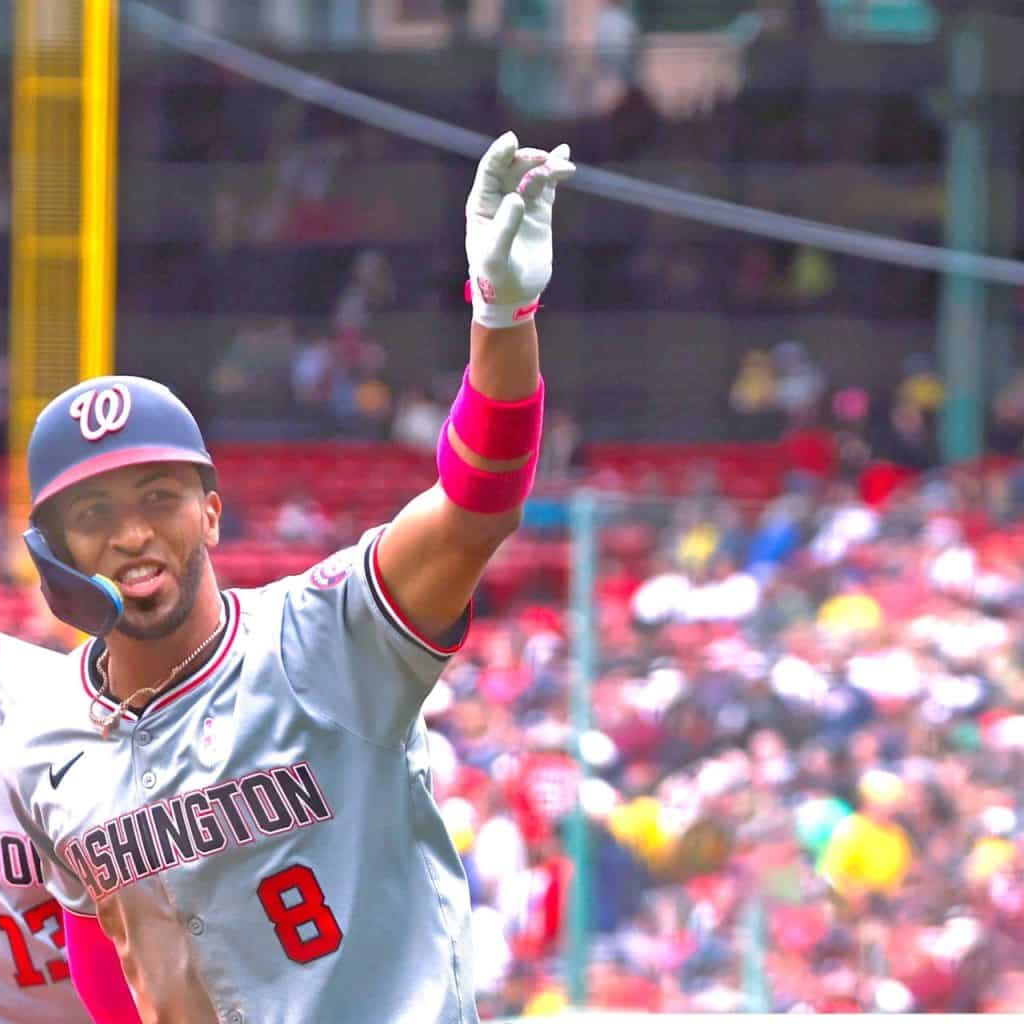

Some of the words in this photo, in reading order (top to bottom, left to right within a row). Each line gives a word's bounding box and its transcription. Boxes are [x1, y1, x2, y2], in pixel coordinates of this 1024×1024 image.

[69, 383, 132, 441] W
[65, 761, 333, 900] ASHINGTON
[257, 864, 343, 964] 8
